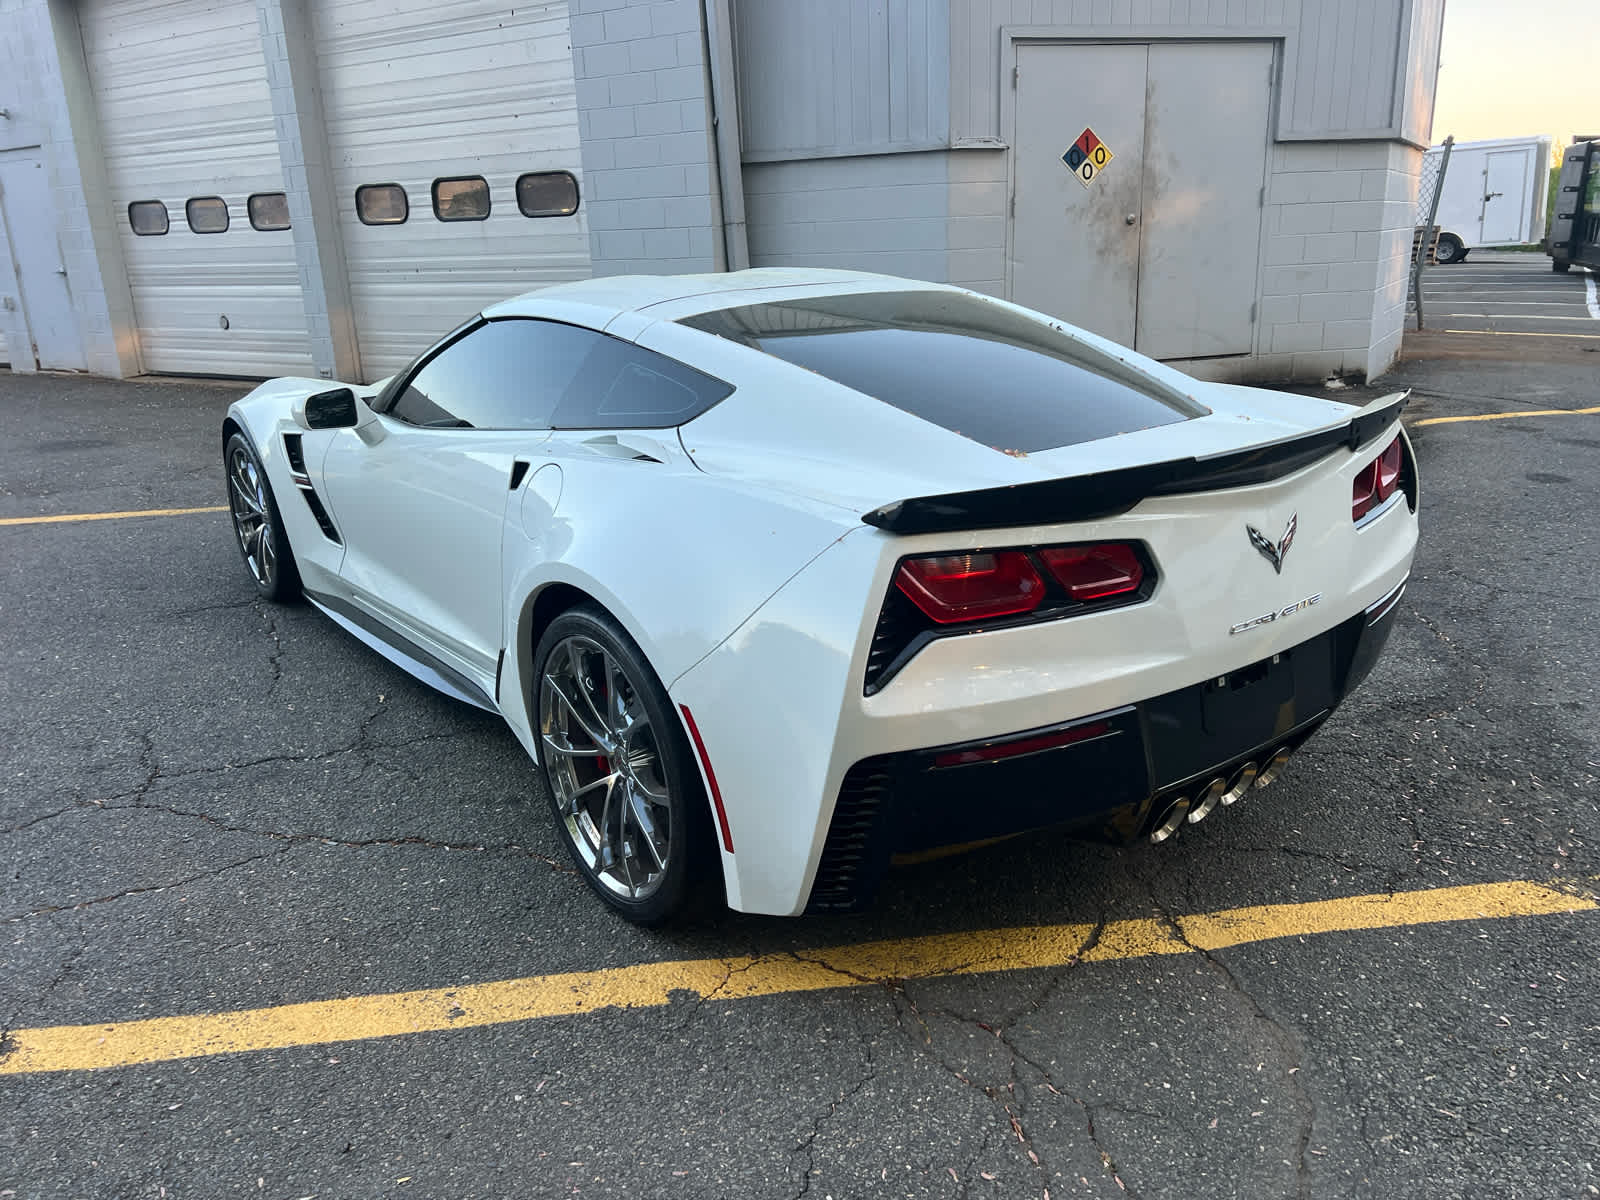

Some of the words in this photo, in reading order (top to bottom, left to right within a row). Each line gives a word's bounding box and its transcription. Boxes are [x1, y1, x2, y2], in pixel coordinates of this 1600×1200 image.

[1070, 149, 1081, 166] 0
[1095, 147, 1106, 165] 0
[1082, 163, 1093, 180] 0
